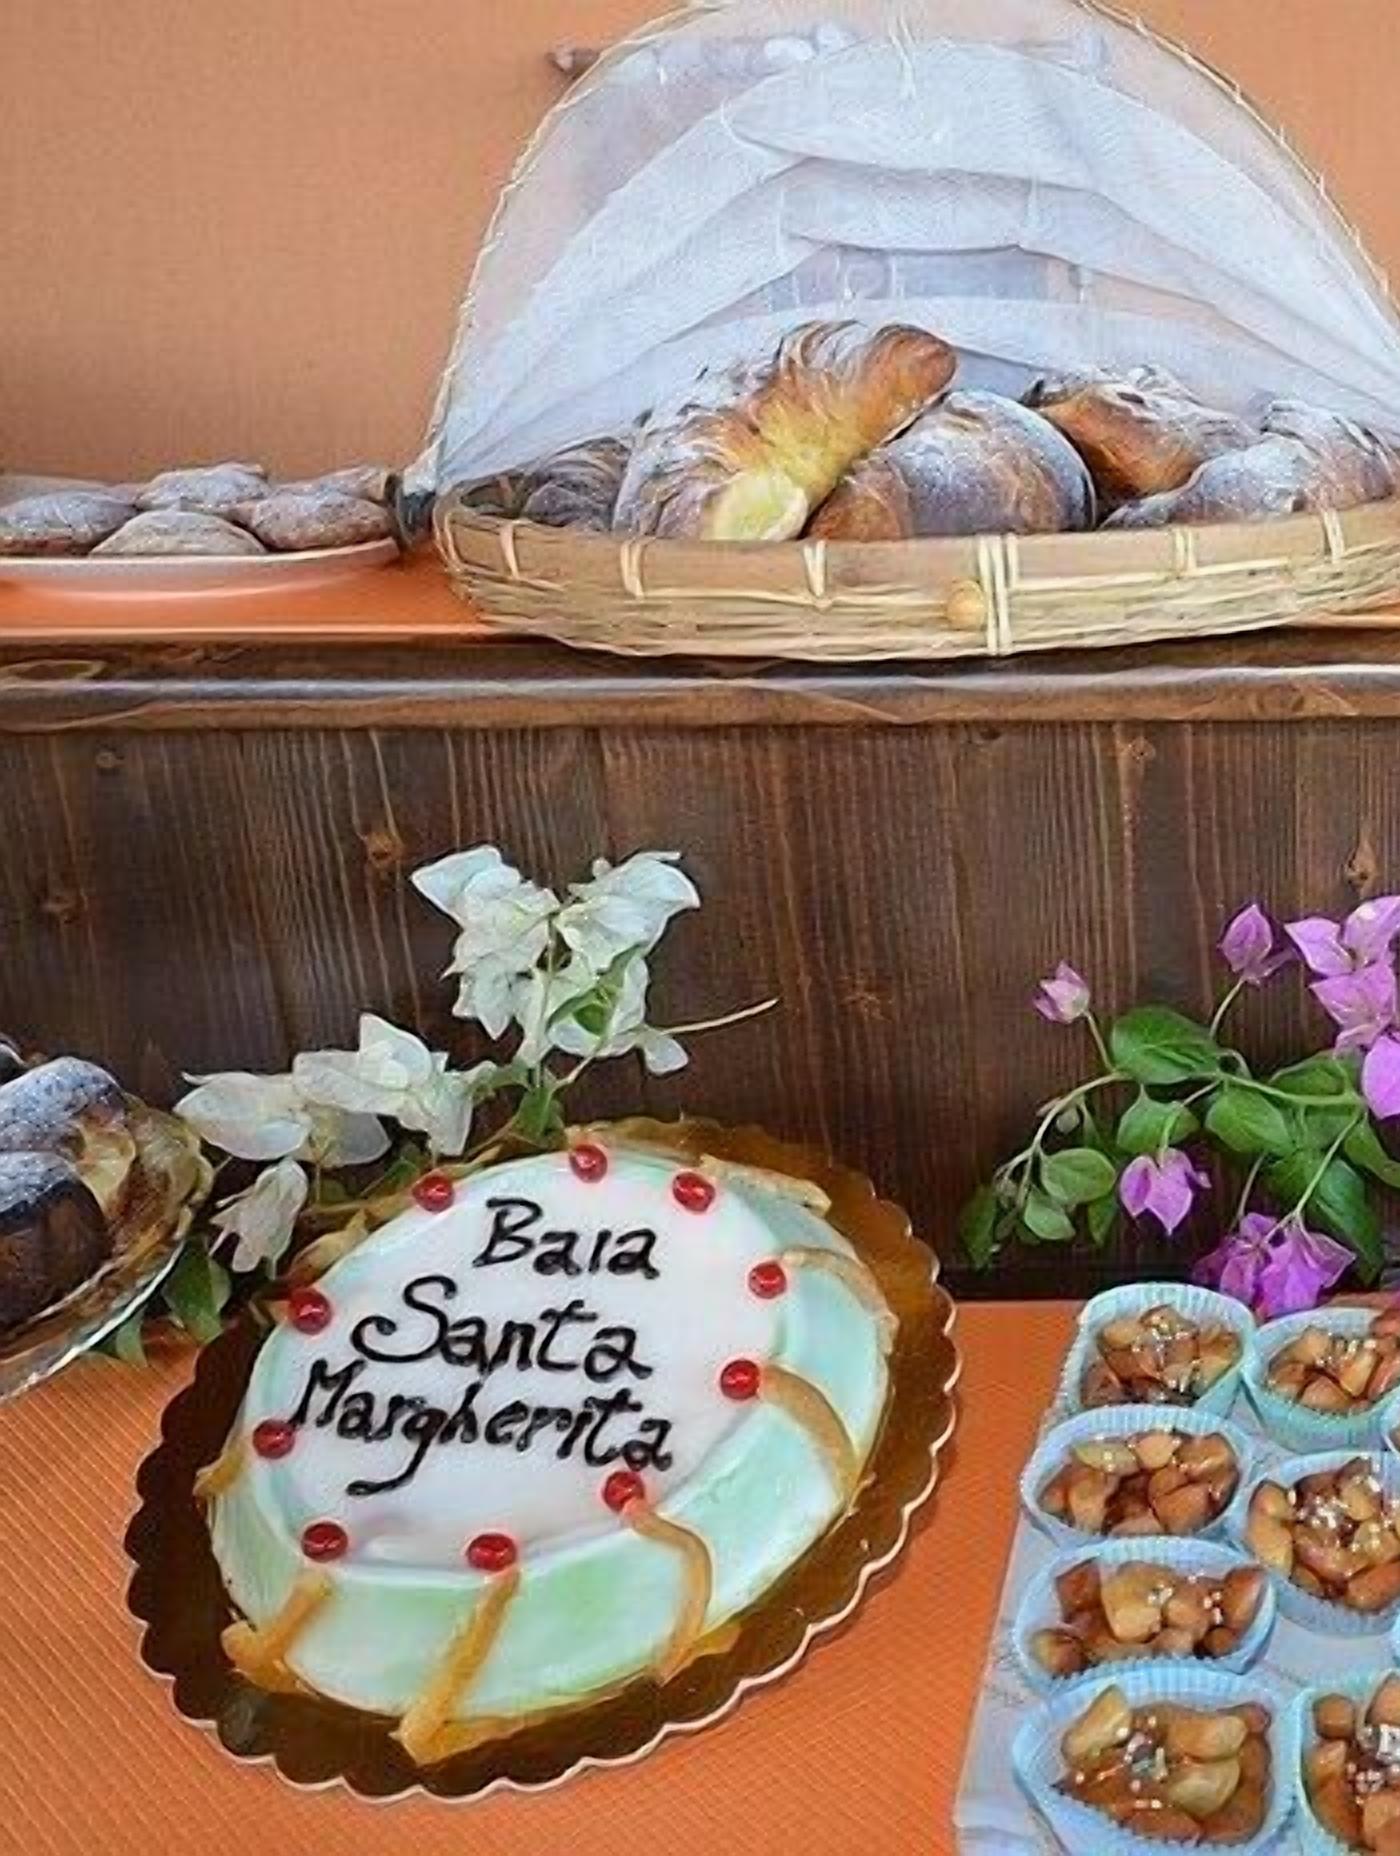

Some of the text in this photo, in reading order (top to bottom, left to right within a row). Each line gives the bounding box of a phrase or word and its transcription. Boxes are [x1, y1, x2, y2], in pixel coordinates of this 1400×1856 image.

[474, 1197, 659, 1280] Baia
[351, 1275, 655, 1382] Santa
[290, 1358, 673, 1496] Margherita
